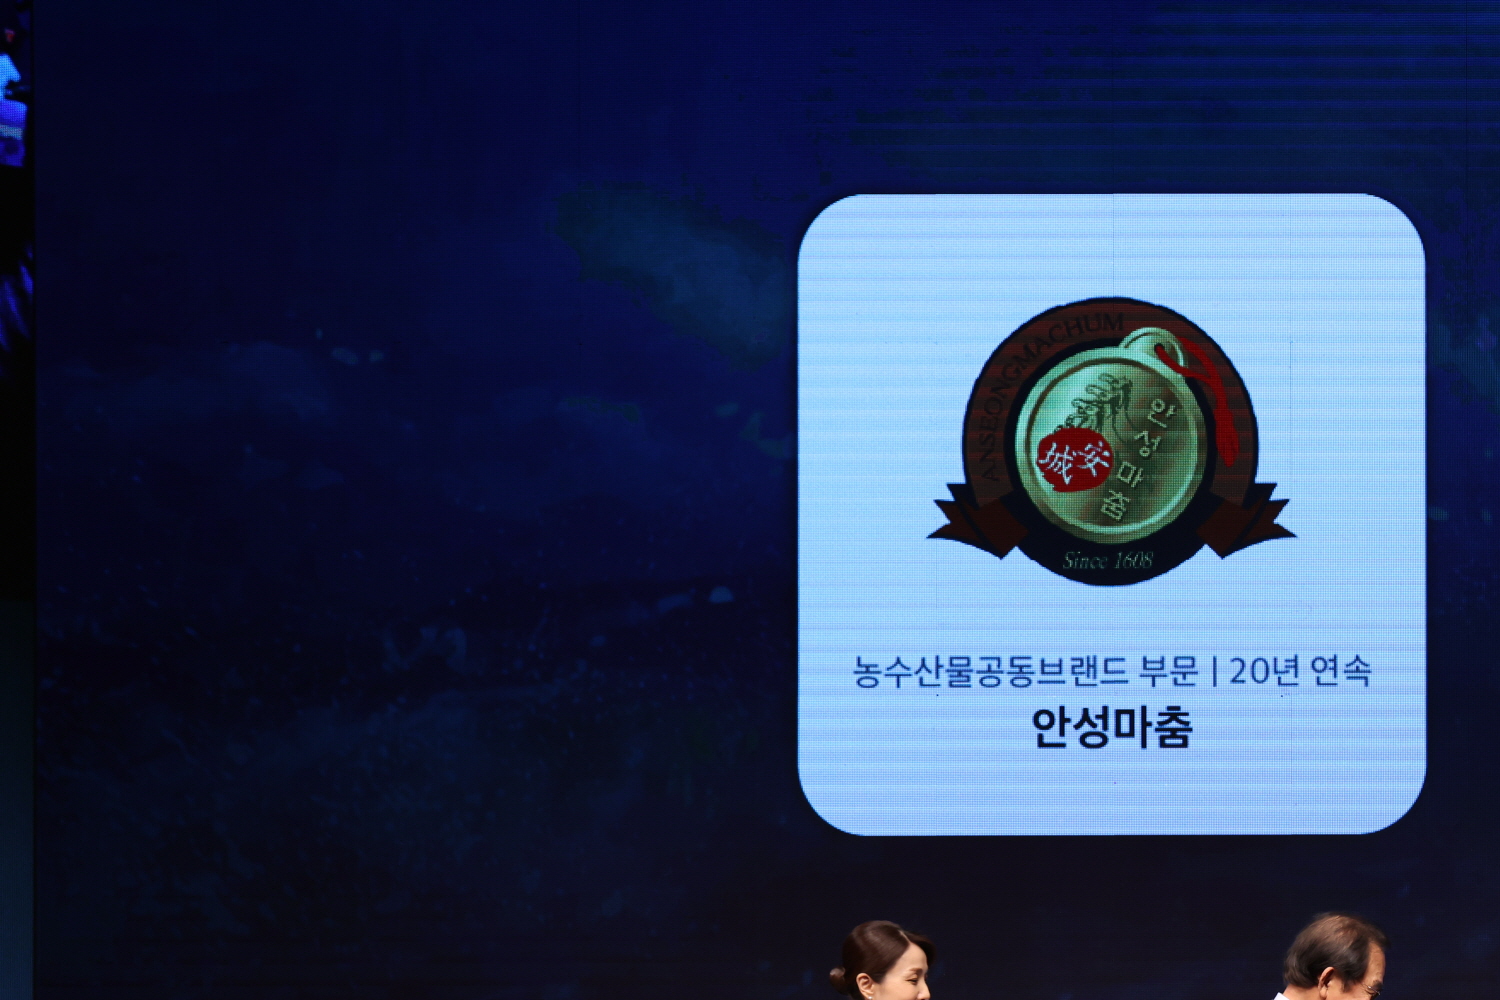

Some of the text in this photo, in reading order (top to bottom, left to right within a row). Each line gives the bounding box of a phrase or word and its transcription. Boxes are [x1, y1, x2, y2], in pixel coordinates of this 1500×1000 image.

[981, 311, 1126, 482] ANSEONGMACHUM
[1062, 550, 1154, 570] Since 1608
[853, 654, 1129, 689] 농수산물공동브랜드
[1139, 654, 1199, 689] 부문
[1230, 654, 1301, 689] 20년
[1310, 654, 1372, 689] 연속
[1032, 704, 1194, 750] 안성마춤
